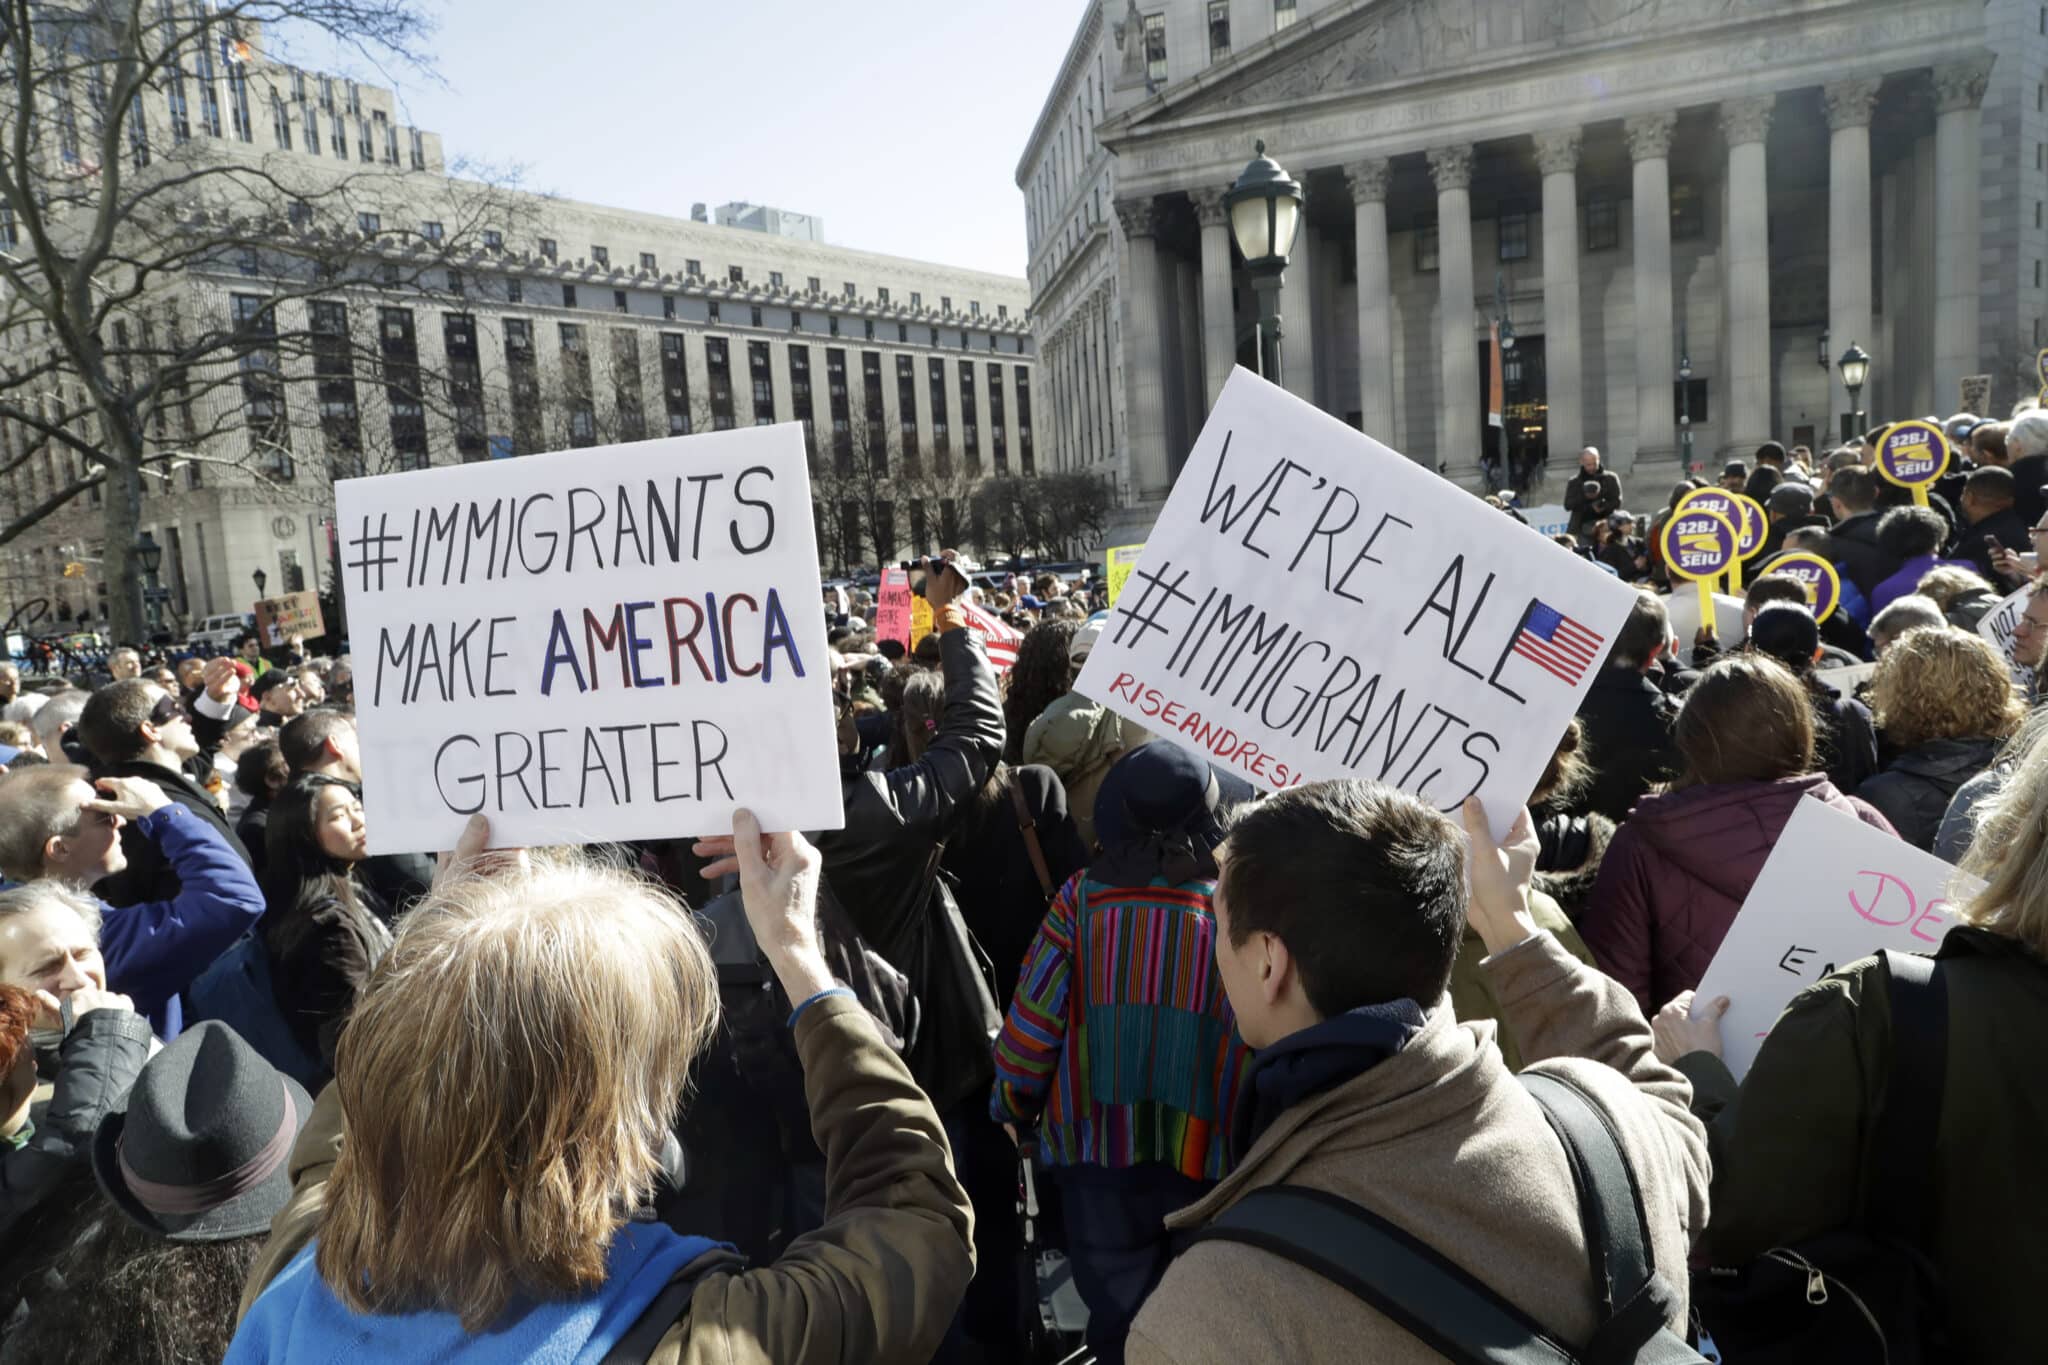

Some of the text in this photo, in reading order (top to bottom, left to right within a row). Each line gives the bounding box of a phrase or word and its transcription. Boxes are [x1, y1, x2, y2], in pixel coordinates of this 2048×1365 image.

[1889, 430, 1930, 449] 32BJ
[1895, 459, 1935, 478] SEIU
[347, 465, 775, 593] #IMMIGRANTS
[1676, 519, 1719, 536] 32BJ
[1680, 552, 1722, 568] SEIU
[1200, 429, 1527, 706] WE'RE ALL
[373, 587, 806, 707] MAKE AMERICA
[1989, 601, 2017, 648] NOT
[1111, 561, 1501, 814] #IMMIGRANTS
[433, 719, 735, 816] GREATER
[1848, 870, 1952, 943] DE
